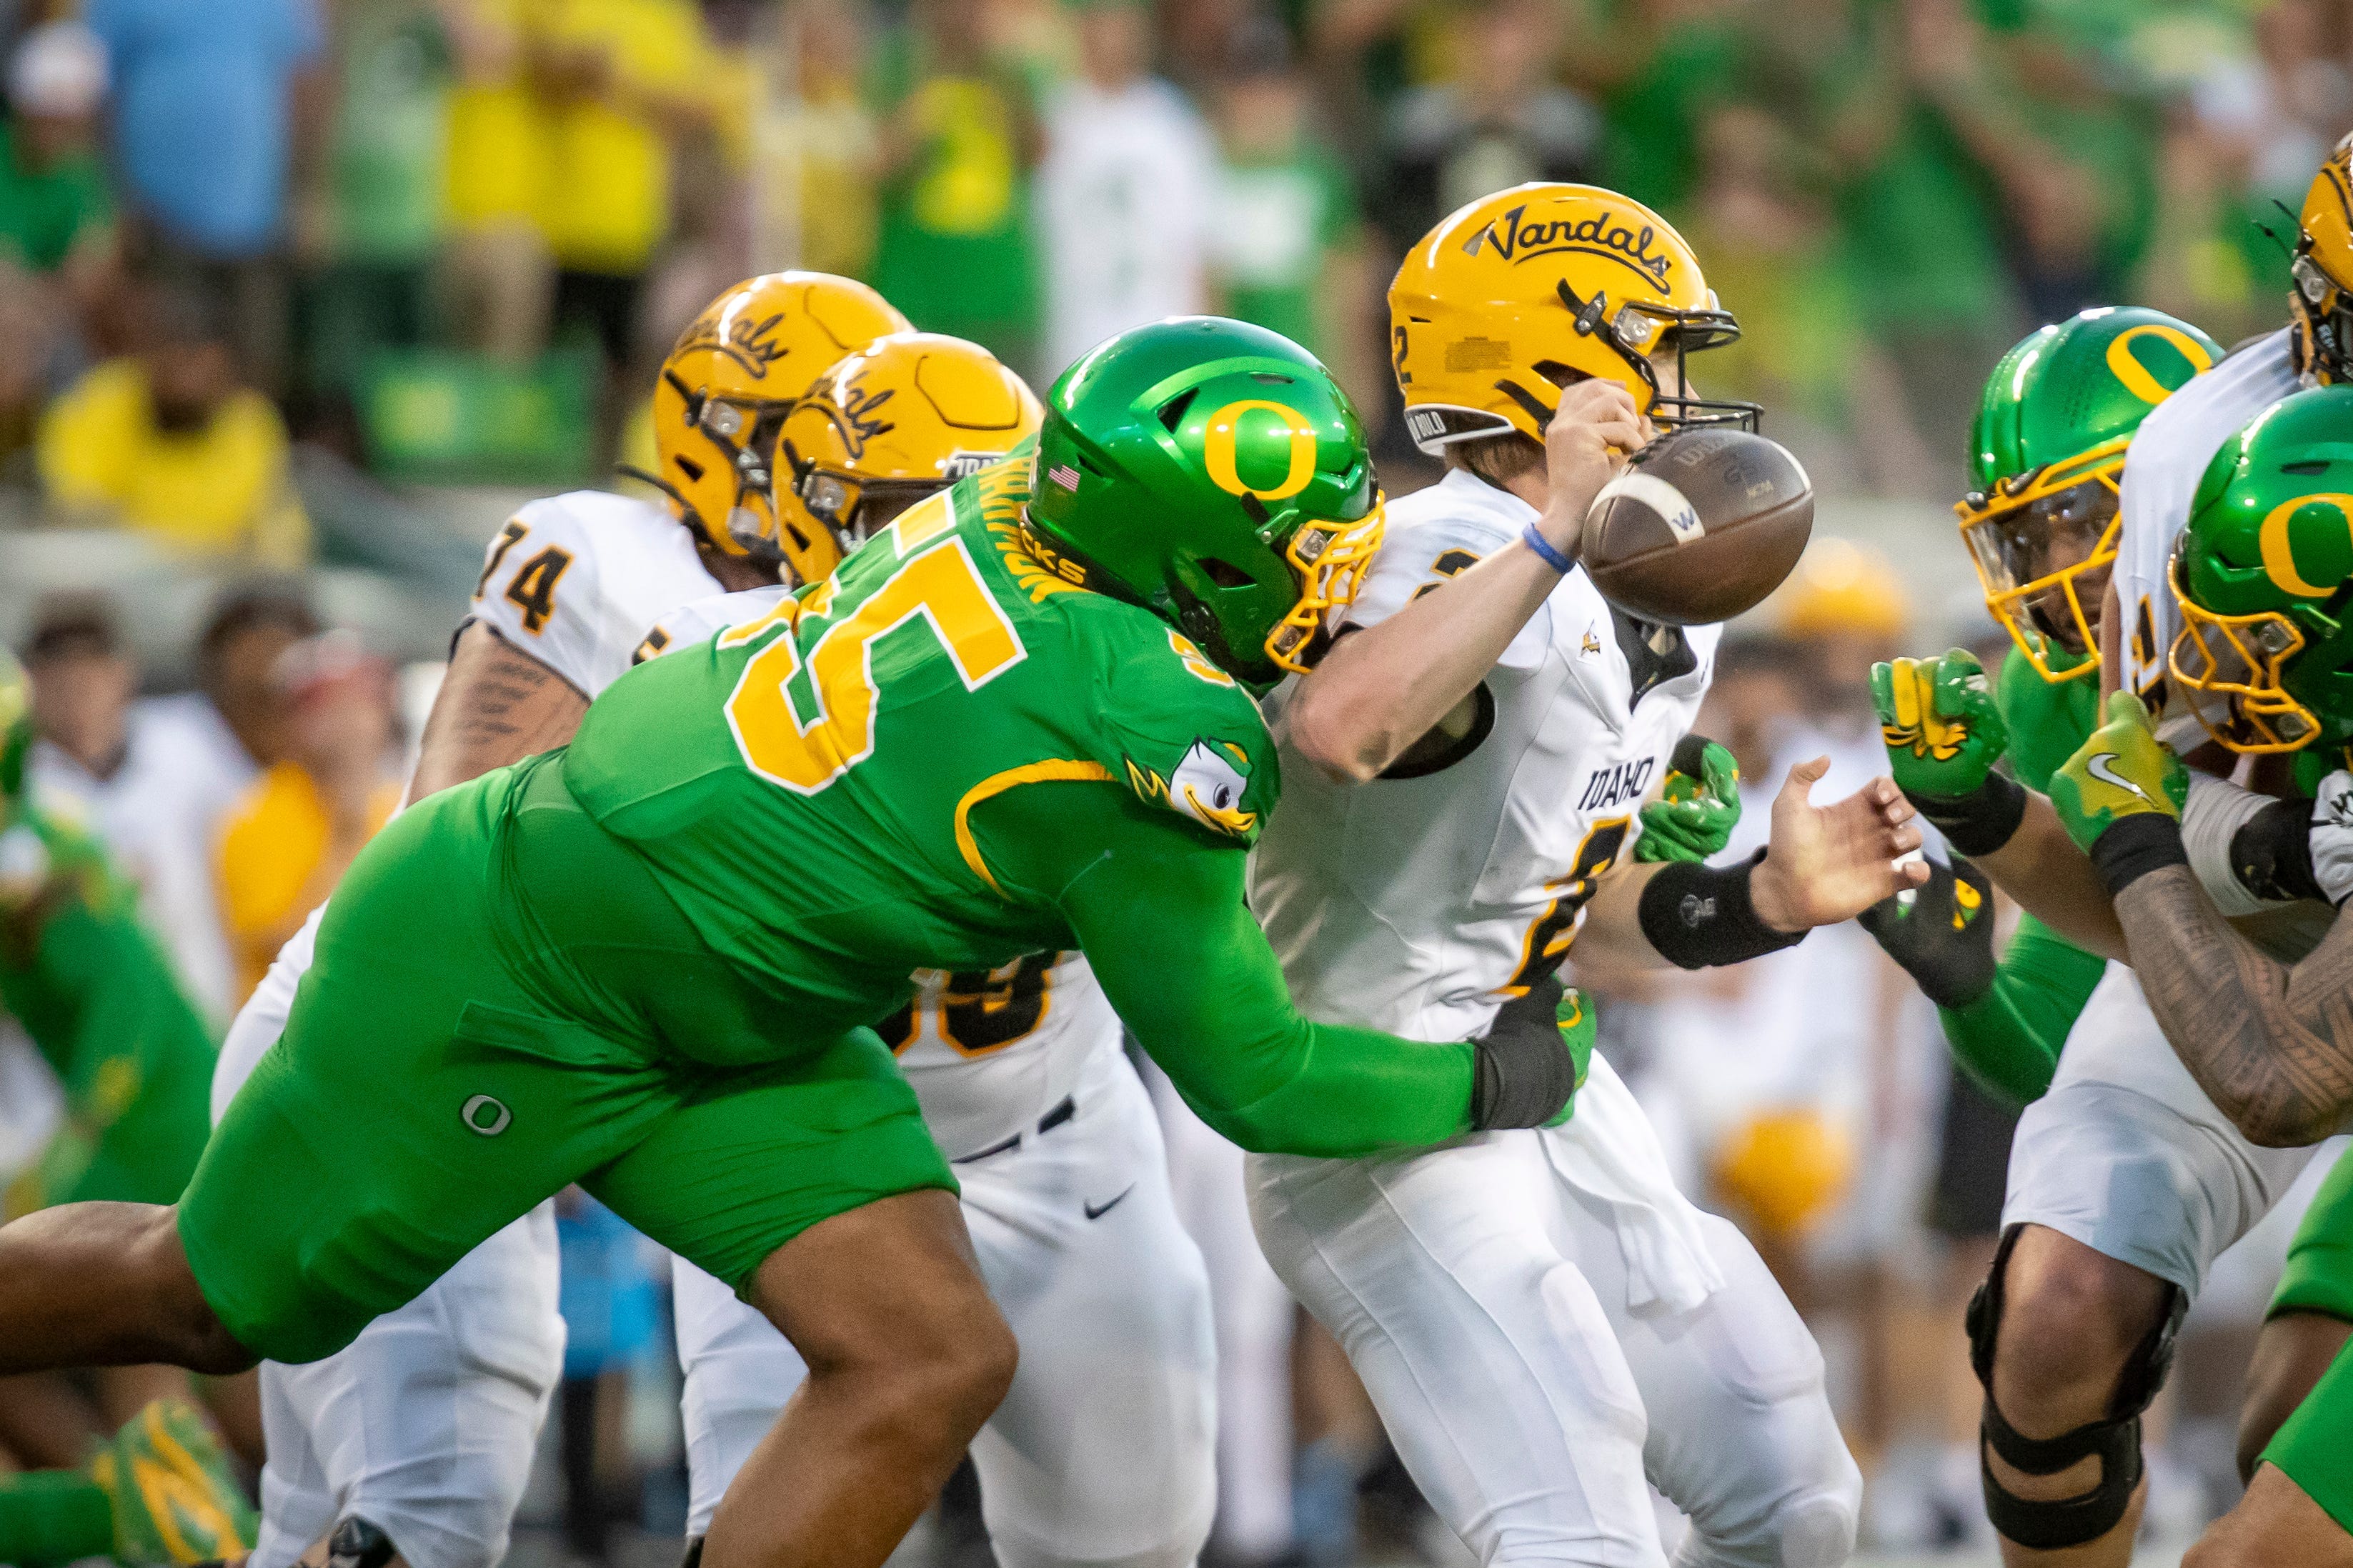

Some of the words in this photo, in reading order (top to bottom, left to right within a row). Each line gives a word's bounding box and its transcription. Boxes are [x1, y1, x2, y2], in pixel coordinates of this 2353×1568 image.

[1486, 204, 1671, 295] Vandals
[2106, 325, 2212, 404] O
[1205, 400, 1317, 501] O
[1672, 508, 1695, 531] W
[2259, 493, 2353, 597] O
[472, 517, 575, 637] 74
[1577, 756, 1655, 811] IDAHO
[460, 1093, 512, 1137] O
